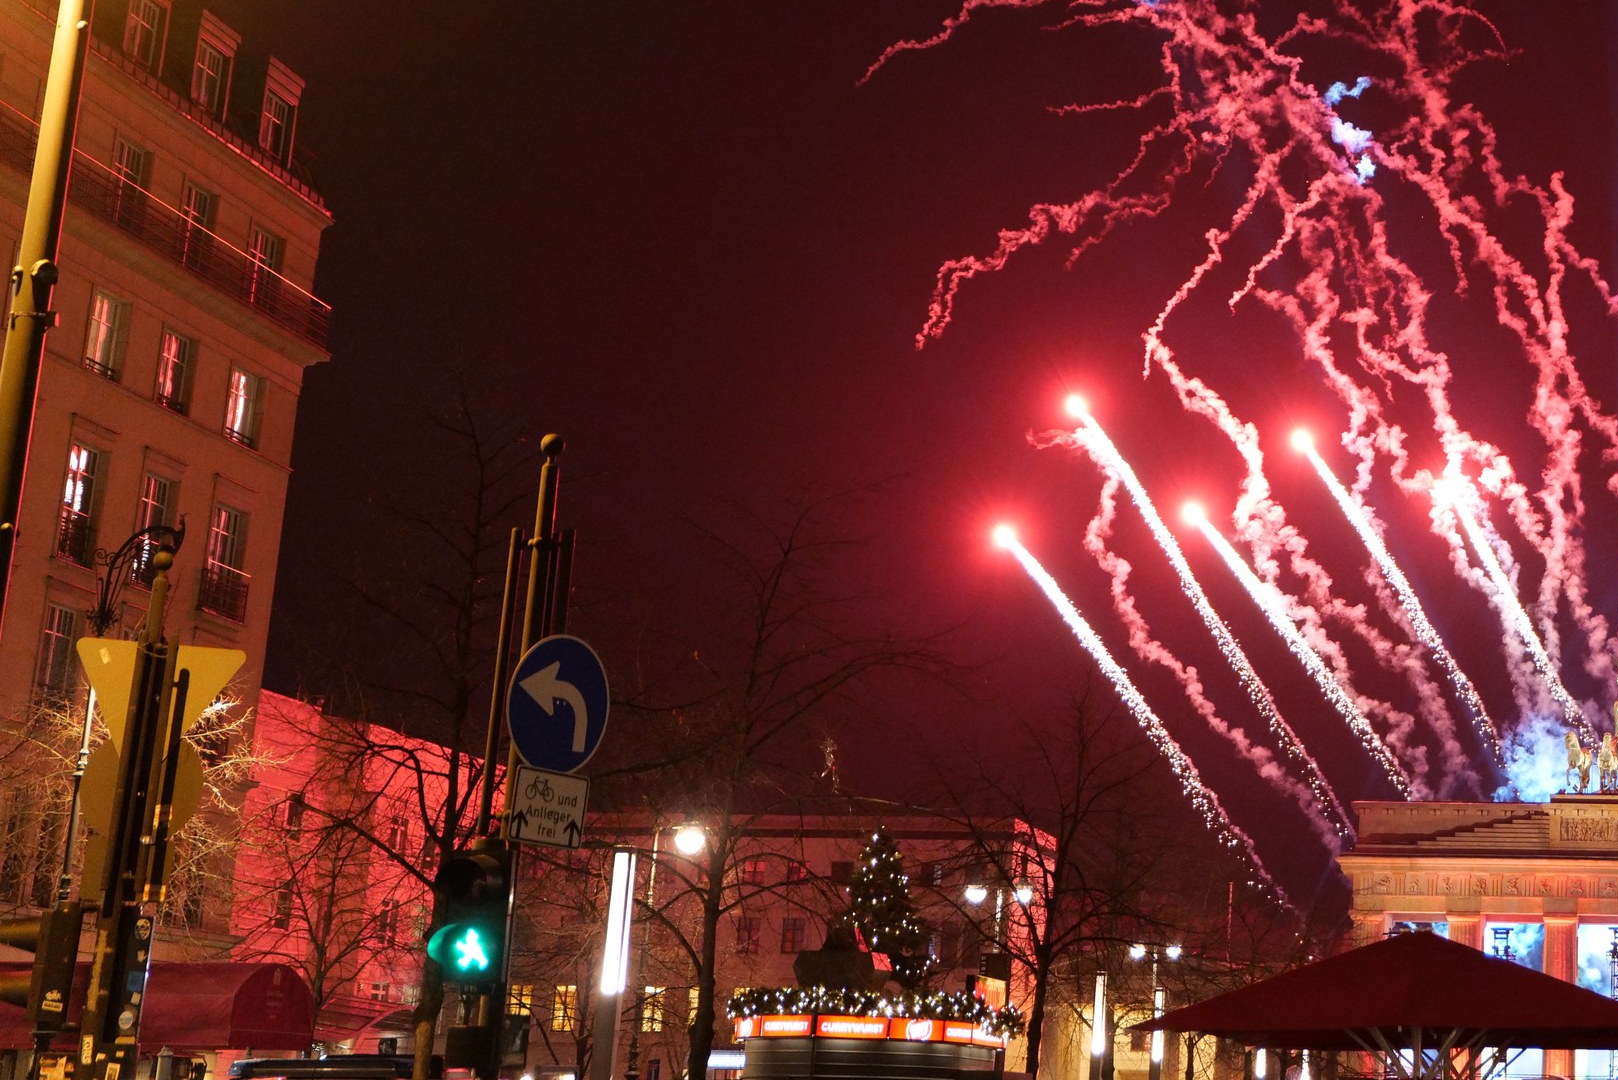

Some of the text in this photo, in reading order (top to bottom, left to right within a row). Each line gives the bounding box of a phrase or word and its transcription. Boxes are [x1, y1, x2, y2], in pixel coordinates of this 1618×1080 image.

[558, 795, 577, 807] und
[538, 823, 555, 838] frei
[821, 1021, 884, 1034] CURRYWURST
